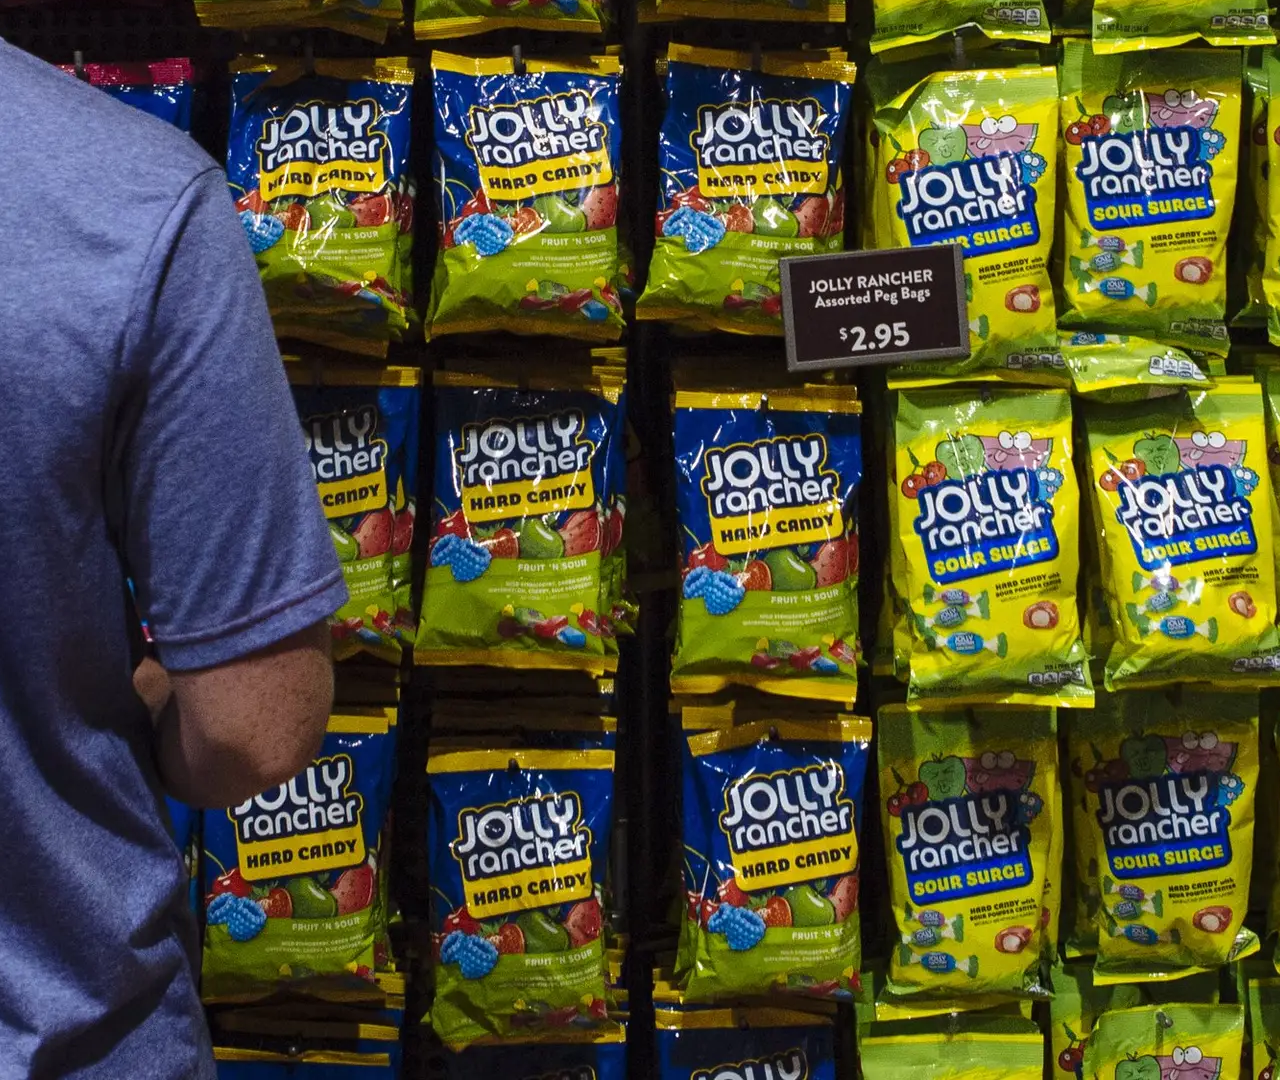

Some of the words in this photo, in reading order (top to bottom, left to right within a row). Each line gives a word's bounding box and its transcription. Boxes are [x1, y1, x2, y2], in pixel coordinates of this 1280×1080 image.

[472, 95, 585, 143] JOLLY
[482, 124, 600, 165] rancher
[488, 173, 538, 190] HARD
[542, 161, 603, 182] CANDY
[541, 237, 569, 246] FRUIT
[584, 234, 607, 243] SOUR
[809, 276, 853, 294] JOLLY
[857, 269, 933, 289] RANCHER
[815, 291, 870, 308] Assorted
[875, 290, 898, 306] Peg
[902, 286, 931, 303] Bags
[839, 322, 910, 352] $2.95
[707, 440, 820, 491] JOLLY
[715, 476, 833, 514] rancher
[920, 473, 1028, 529] JOLLY
[720, 526, 771, 543] HARD
[776, 513, 835, 533] CANDY
[928, 507, 1045, 550] rancher
[934, 551, 986, 575] SOUR
[989, 538, 1051, 562] SURGE
[770, 594, 798, 604] FRUIT
[814, 588, 839, 601] SOUR
[242, 799, 356, 839] rancher
[247, 849, 293, 869] HARD
[298, 838, 357, 860] CANDY
[292, 923, 320, 932] FRUIT
[334, 918, 360, 928] SOUR
